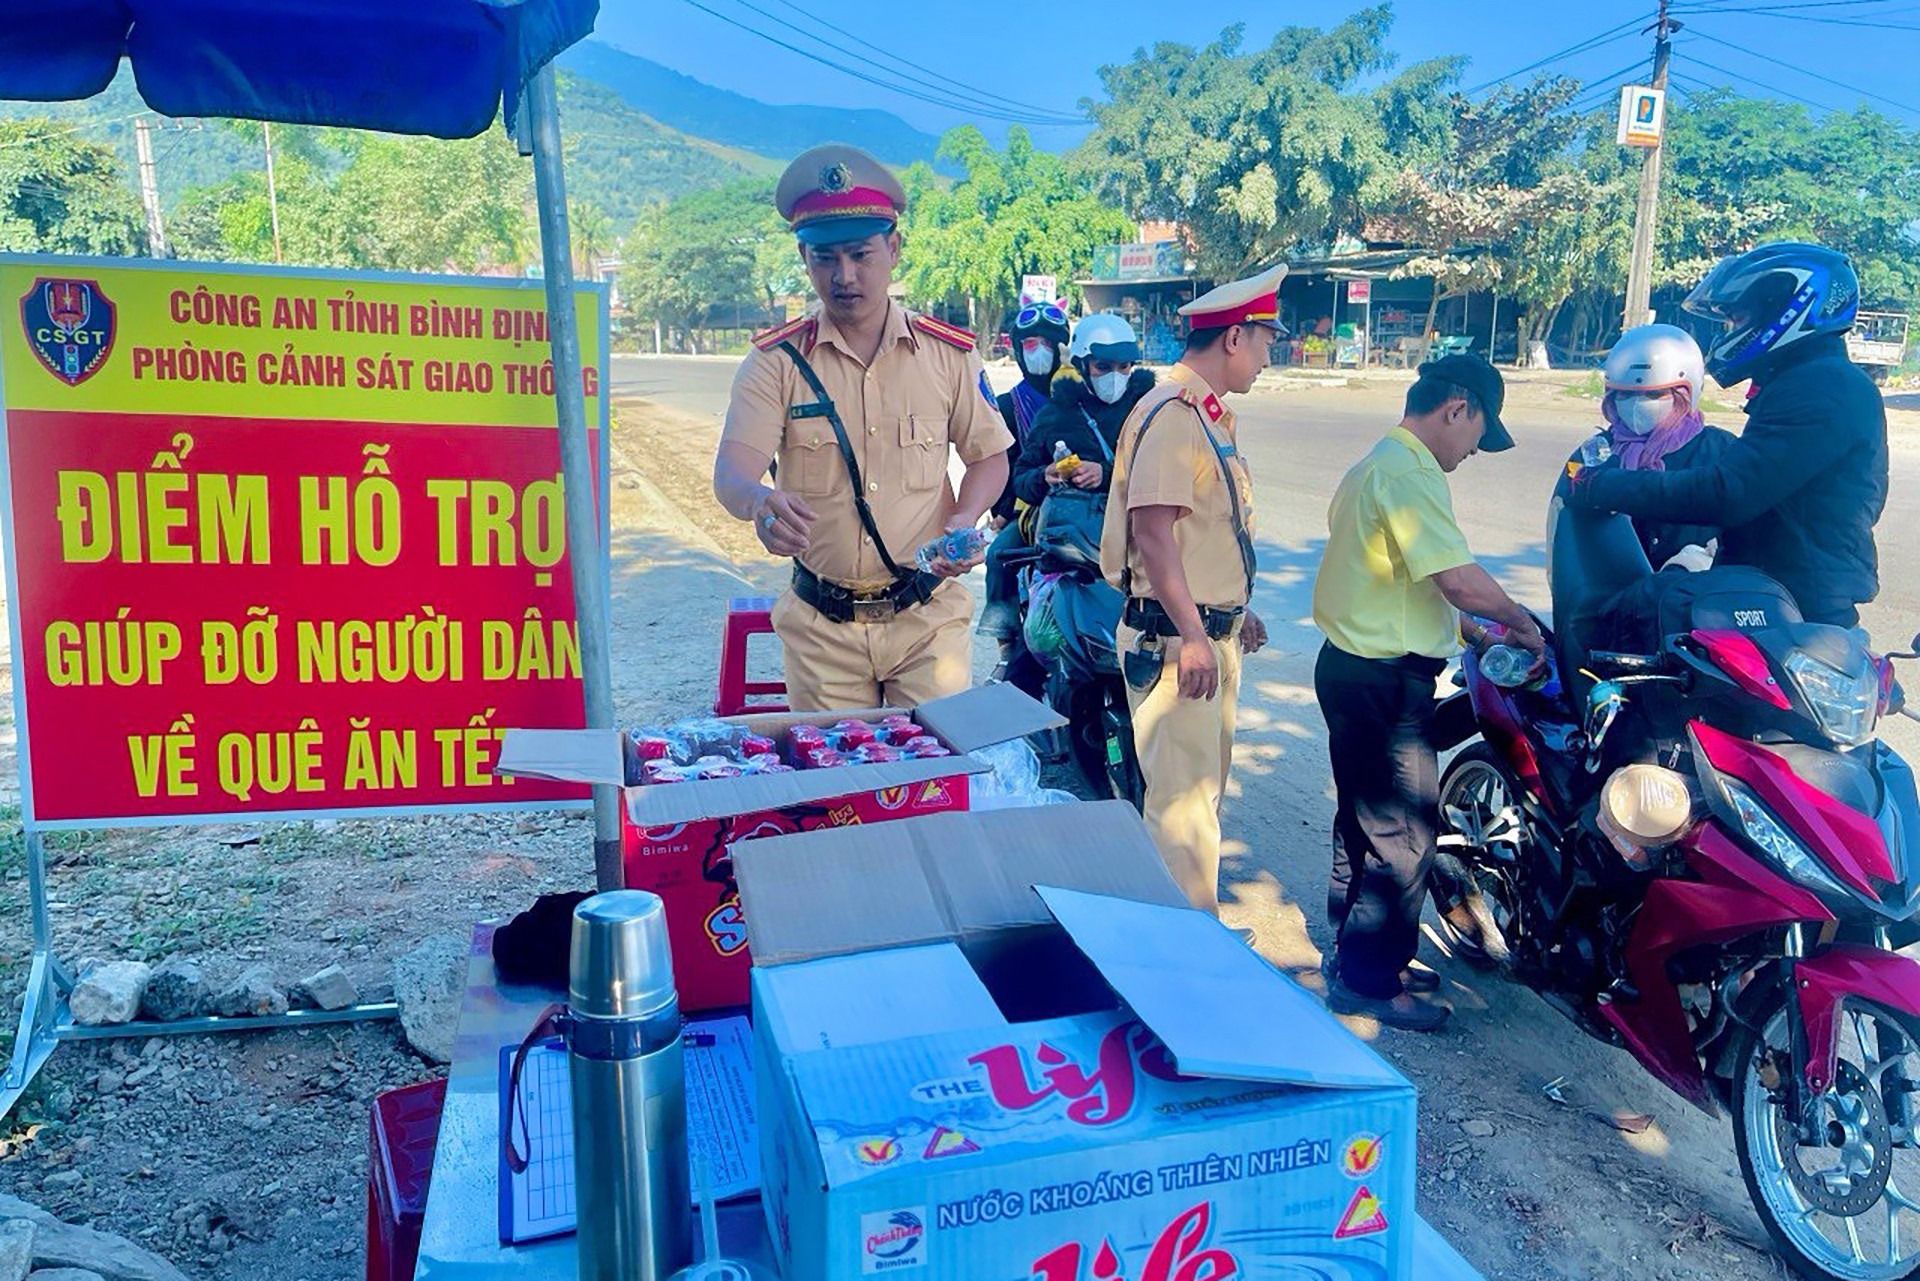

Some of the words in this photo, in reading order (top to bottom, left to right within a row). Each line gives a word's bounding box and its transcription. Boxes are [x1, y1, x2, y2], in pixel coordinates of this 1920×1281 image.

[36, 328, 104, 345] CSGT
[170, 285, 261, 330] CÔNG
[273, 298, 318, 331] AN
[327, 290, 399, 335] TỈNH
[410, 302, 482, 338] BÌNH
[492, 308, 551, 348] ĐỊN
[133, 341, 246, 384] PHÒNG
[258, 343, 345, 387] CẢNH
[357, 353, 413, 391] SÁT
[425, 361, 493, 393] GIAO
[503, 359, 598, 397] THÔG
[56, 433, 271, 565] ĐIỂM
[300, 443, 402, 566] HỖ
[427, 472, 566, 587] TRỢ
[45, 608, 182, 686] GIÚP
[201, 607, 279, 685] ĐỠ
[298, 606, 463, 684] NGƯỜI
[483, 607, 584, 681] DÂN
[1734, 611, 1767, 627] SPORT
[128, 714, 198, 797] VỀ
[218, 724, 325, 802] QUÊ
[345, 717, 417, 791] ĂN
[642, 844, 689, 856] Bimiwa
[917, 1078, 984, 1099] THE
[937, 1189, 1024, 1229] NƯỚC
[1031, 1170, 1153, 1214] KHOÁNG
[1159, 1152, 1243, 1192] THIÊN
[1248, 1139, 1331, 1176] NHIÊN
